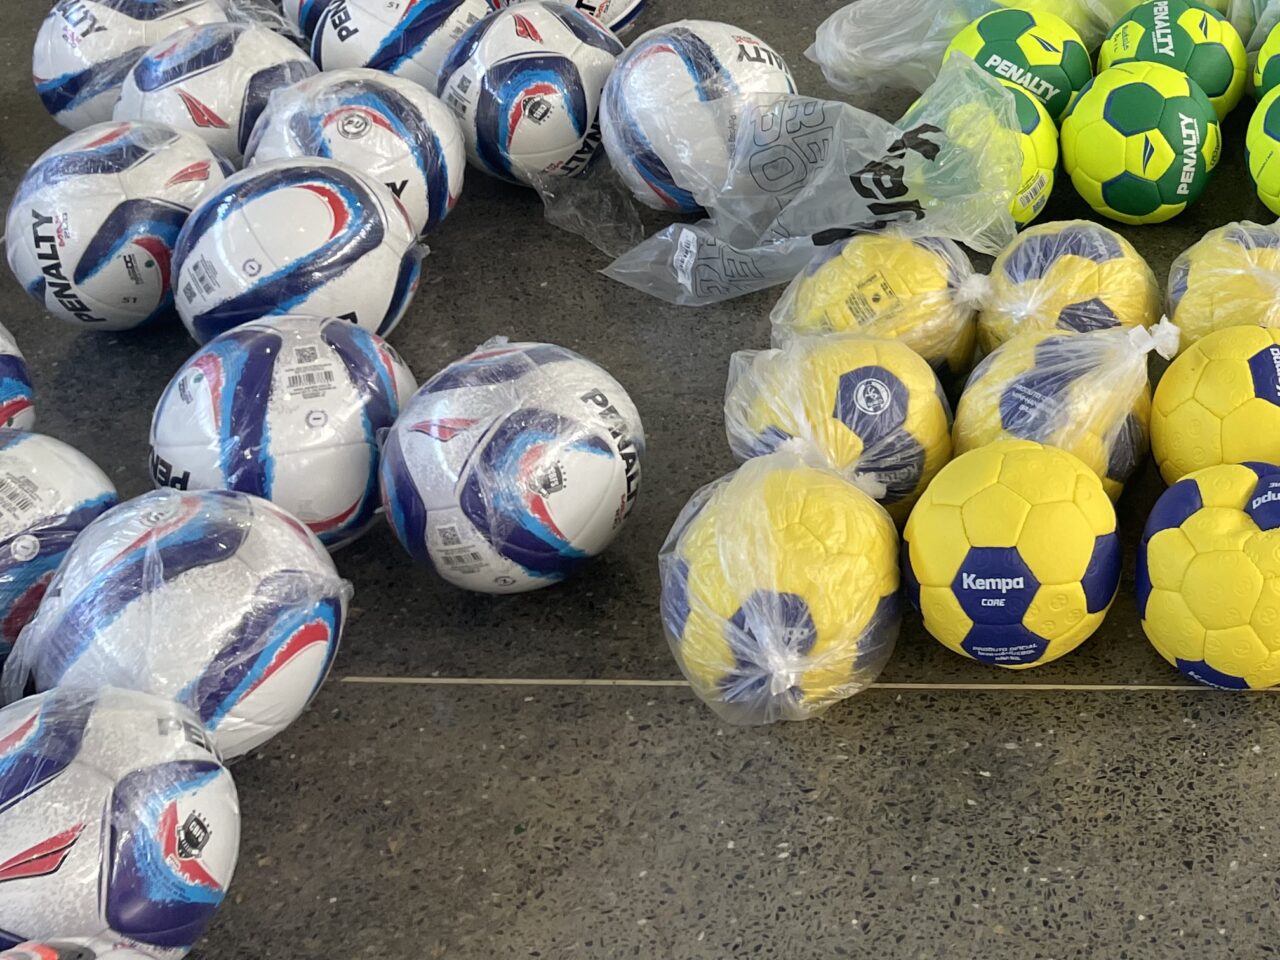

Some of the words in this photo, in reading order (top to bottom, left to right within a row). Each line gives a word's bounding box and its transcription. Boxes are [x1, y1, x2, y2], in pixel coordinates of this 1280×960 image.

[1153, 0, 1176, 58] PENALTY
[736, 43, 790, 78] ALTY
[984, 53, 1061, 102] PENALTY
[1176, 111, 1196, 196] PENALTY
[31, 208, 108, 322] PENALTY
[961, 572, 1025, 594] Kempa
[980, 597, 1007, 607] CORE
